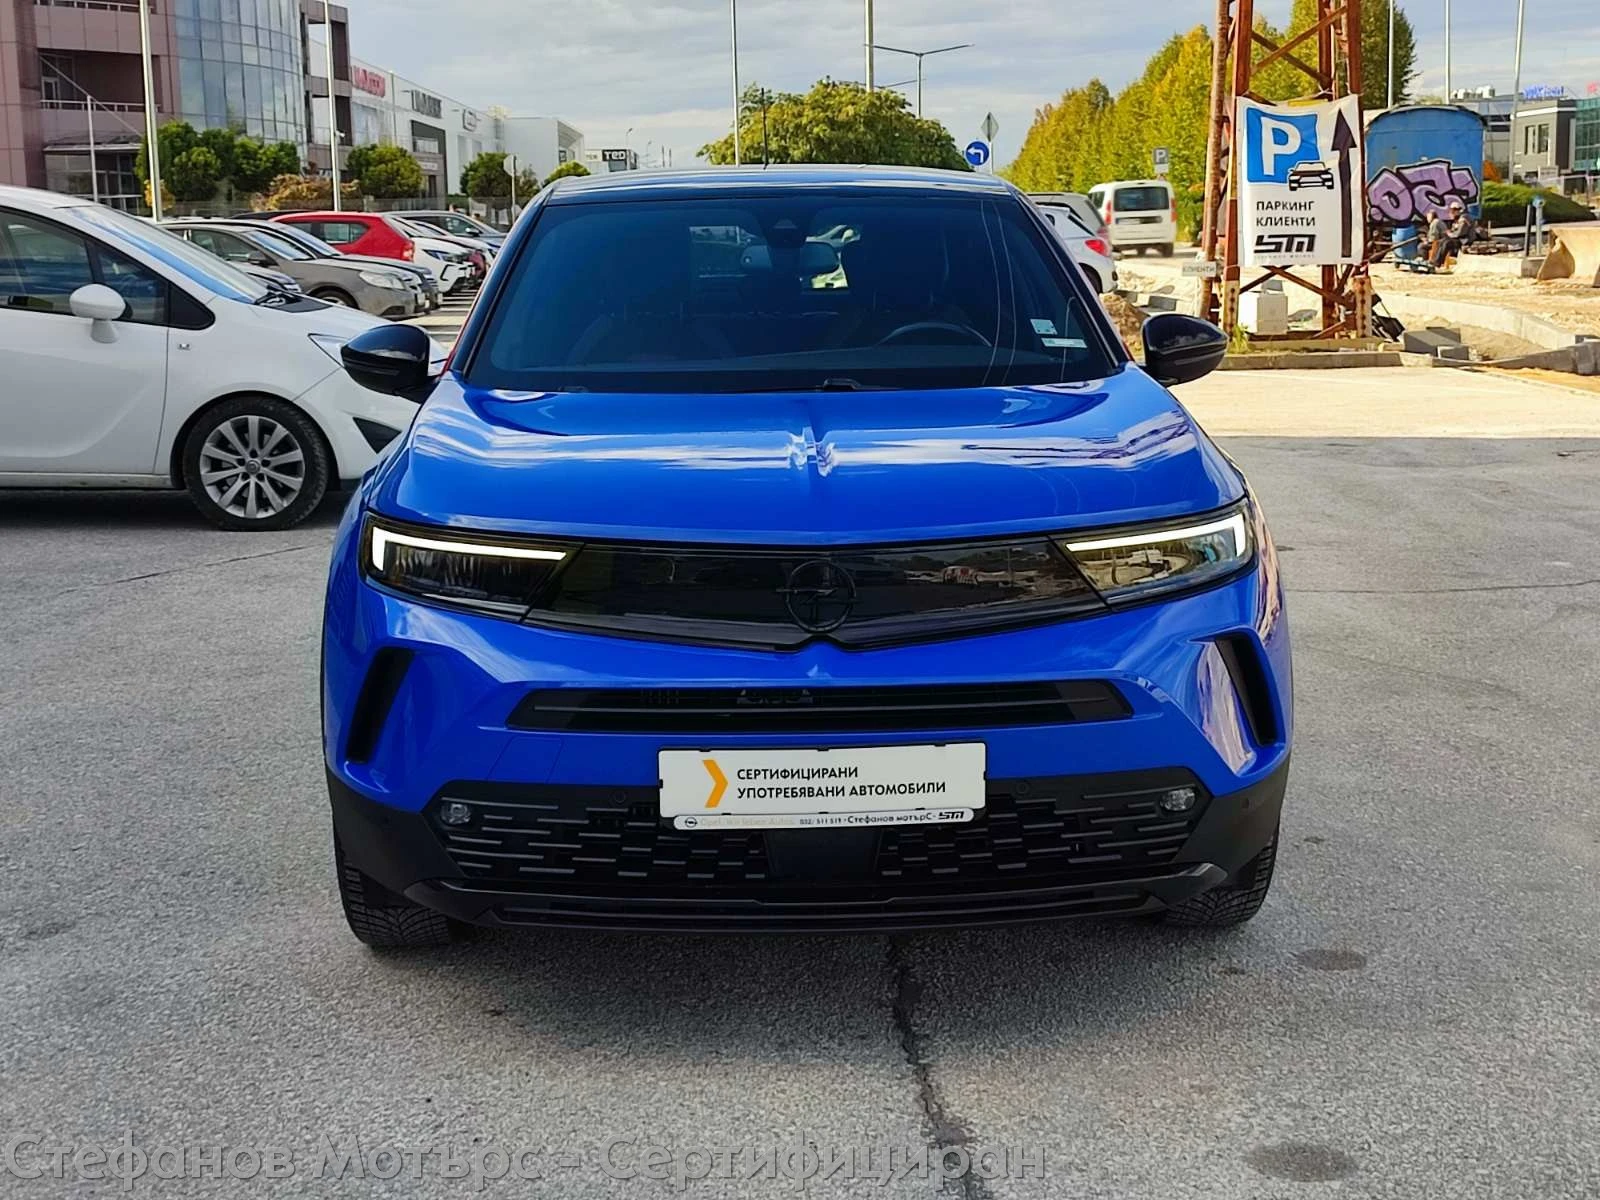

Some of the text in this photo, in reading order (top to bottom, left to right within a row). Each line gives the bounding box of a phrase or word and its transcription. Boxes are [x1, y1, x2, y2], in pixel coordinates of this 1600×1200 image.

[1260, 116, 1301, 176] P
[1155, 149, 1166, 163] P
[1256, 200, 1315, 211] ПАРКИНГ
[1256, 216, 1316, 226] КЛИЕНТИ
[736, 766, 859, 781] СЕРТИФИЦИРАНИ
[737, 782, 947, 799] УПОТРЕБЯВАНИ АВТОМОБИЛИ
